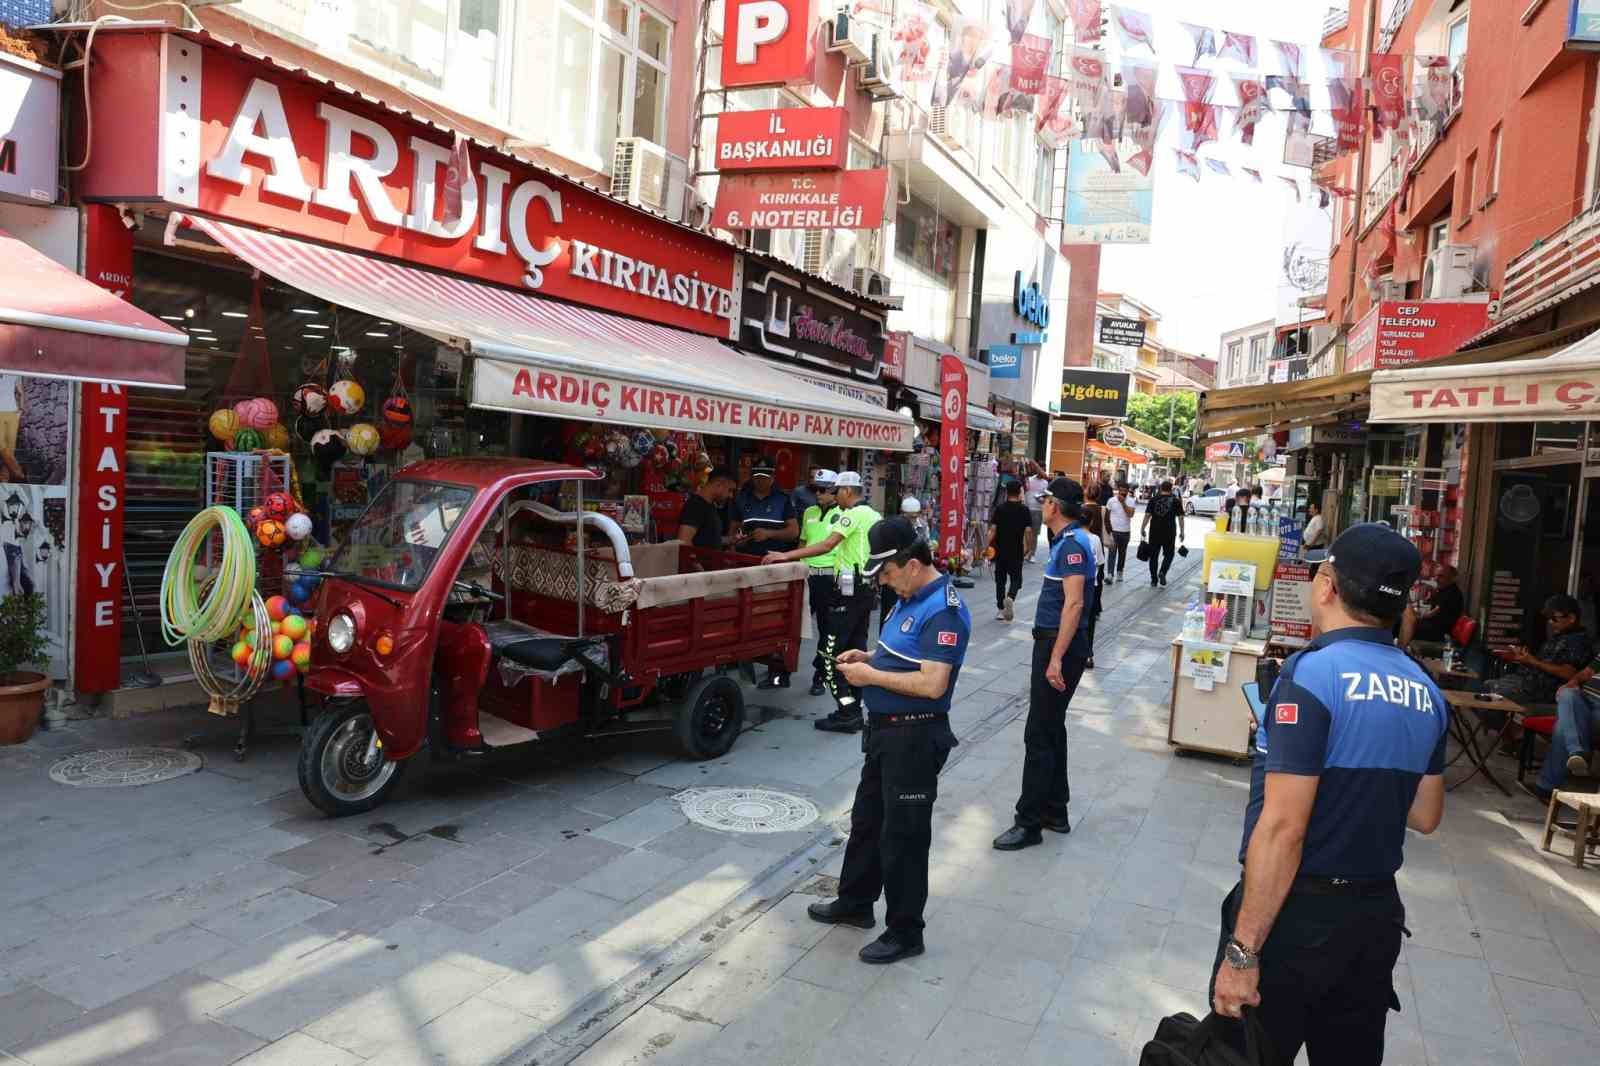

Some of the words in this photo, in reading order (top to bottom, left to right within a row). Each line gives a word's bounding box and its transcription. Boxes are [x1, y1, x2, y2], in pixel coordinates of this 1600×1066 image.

[768, 113, 786, 134] İL
[720, 134, 833, 161] BAŞKANLIĞI
[791, 178, 817, 190] T.C.
[206, 78, 563, 288] ARDIÇ
[570, 240, 731, 320] KIRTASİYE
[759, 193, 840, 205] KIRIKKALE
[727, 210, 744, 227] 6.
[750, 205, 863, 228] NOTERLİĞİ
[1014, 270, 1049, 330] beko
[1397, 306, 1420, 316] CEP
[1380, 317, 1437, 328] TELEFONU
[991, 353, 1017, 364] beko
[511, 367, 610, 417] ARDIÇ
[804, 414, 834, 436] FAX
[1404, 384, 1539, 408] TATLI
[1555, 381, 1600, 412] Ç
[1379, 585, 1402, 597] ZABITA
[1341, 672, 1434, 715] ZABITA
